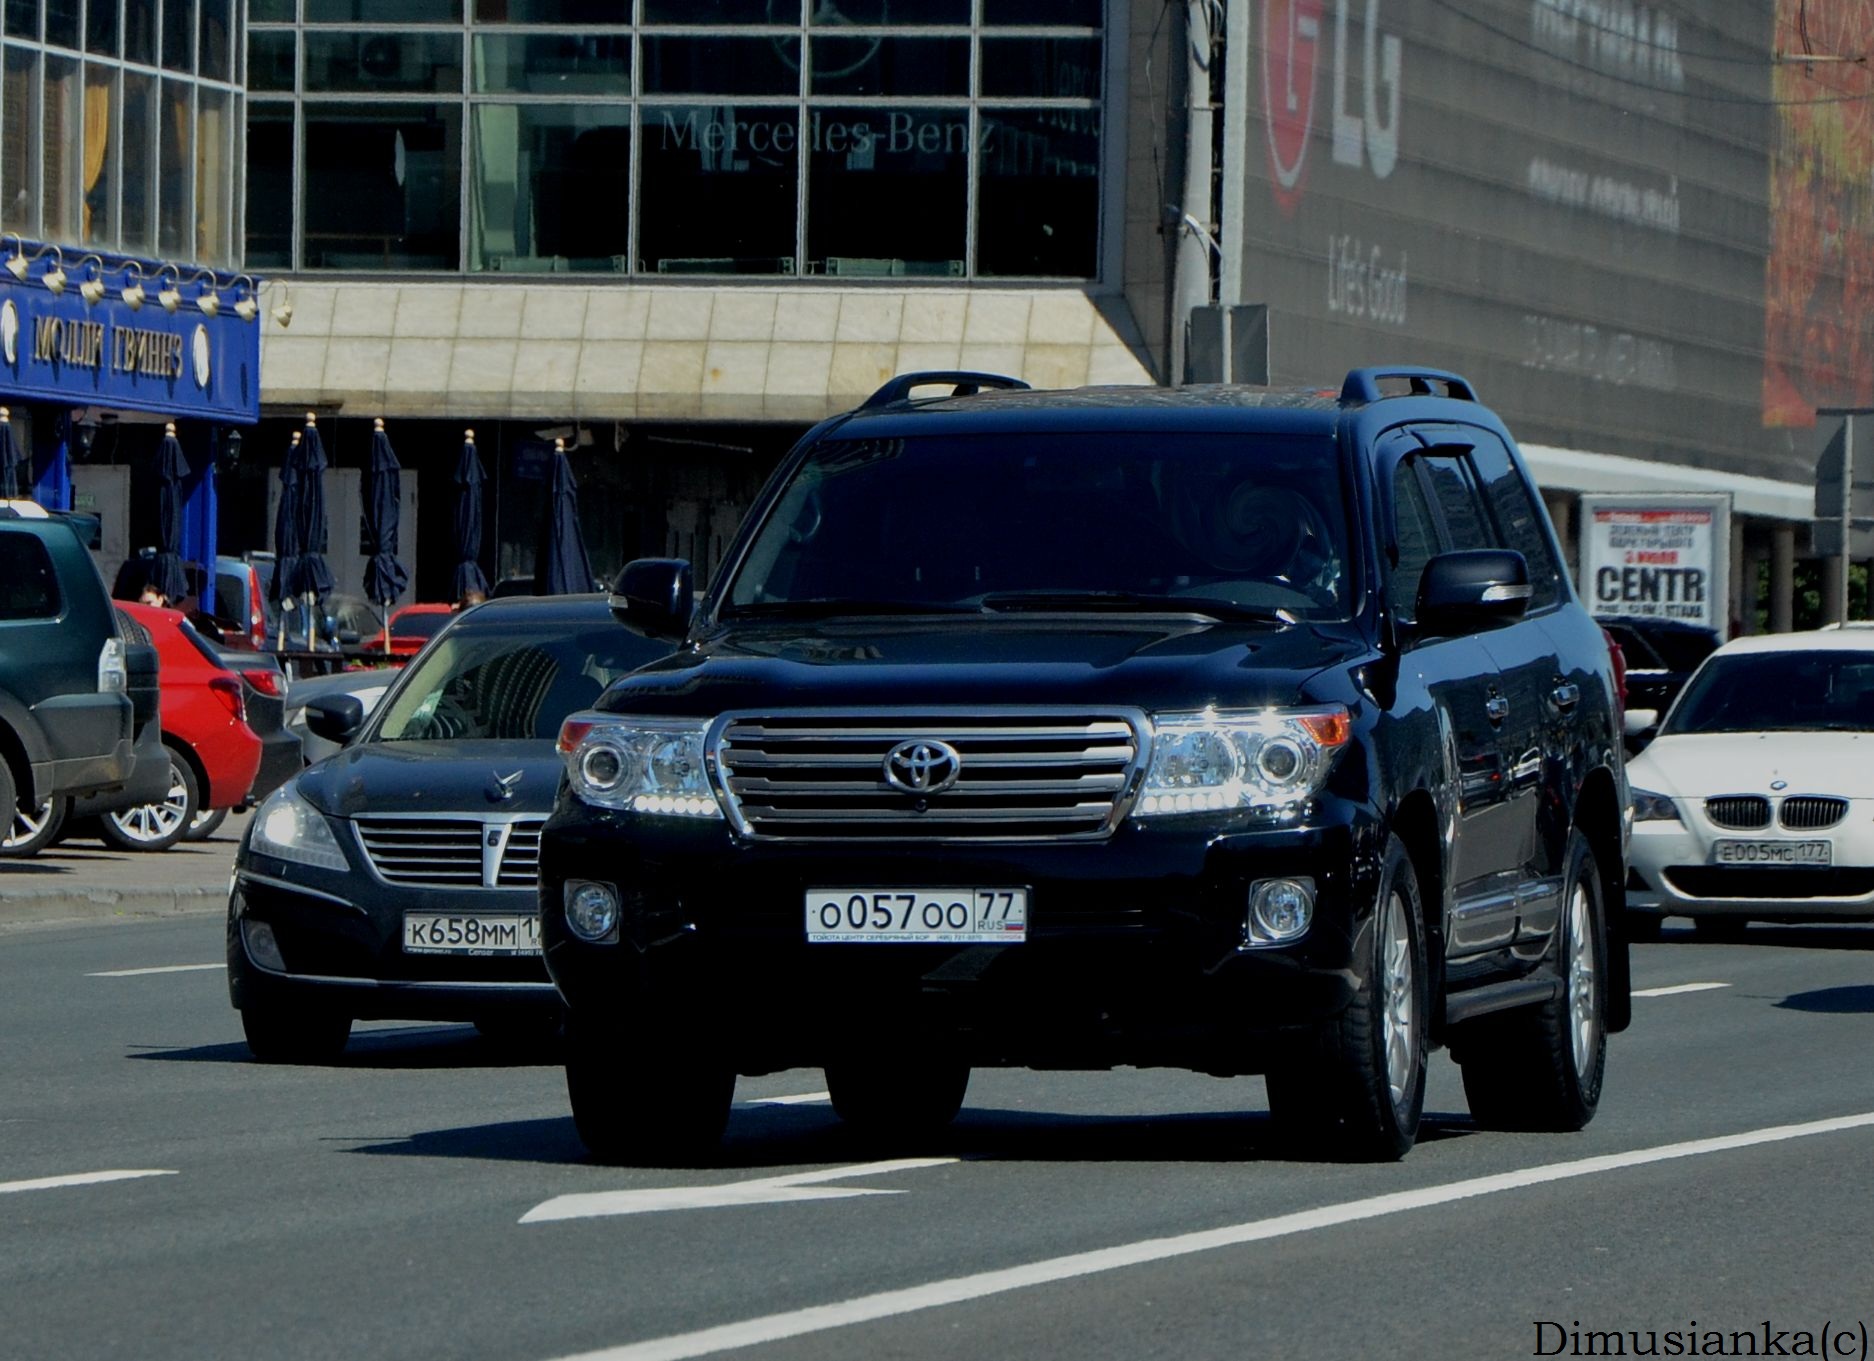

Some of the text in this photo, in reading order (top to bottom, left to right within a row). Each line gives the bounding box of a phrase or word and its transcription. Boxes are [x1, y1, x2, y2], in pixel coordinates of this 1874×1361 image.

[1333, 0, 1401, 179] LG
[34, 315, 183, 379] МОЛЛИ ГВИННЗ
[1596, 565, 1706, 603] CENTR
[979, 892, 1014, 920] 77
[977, 920, 1004, 931] RUS
